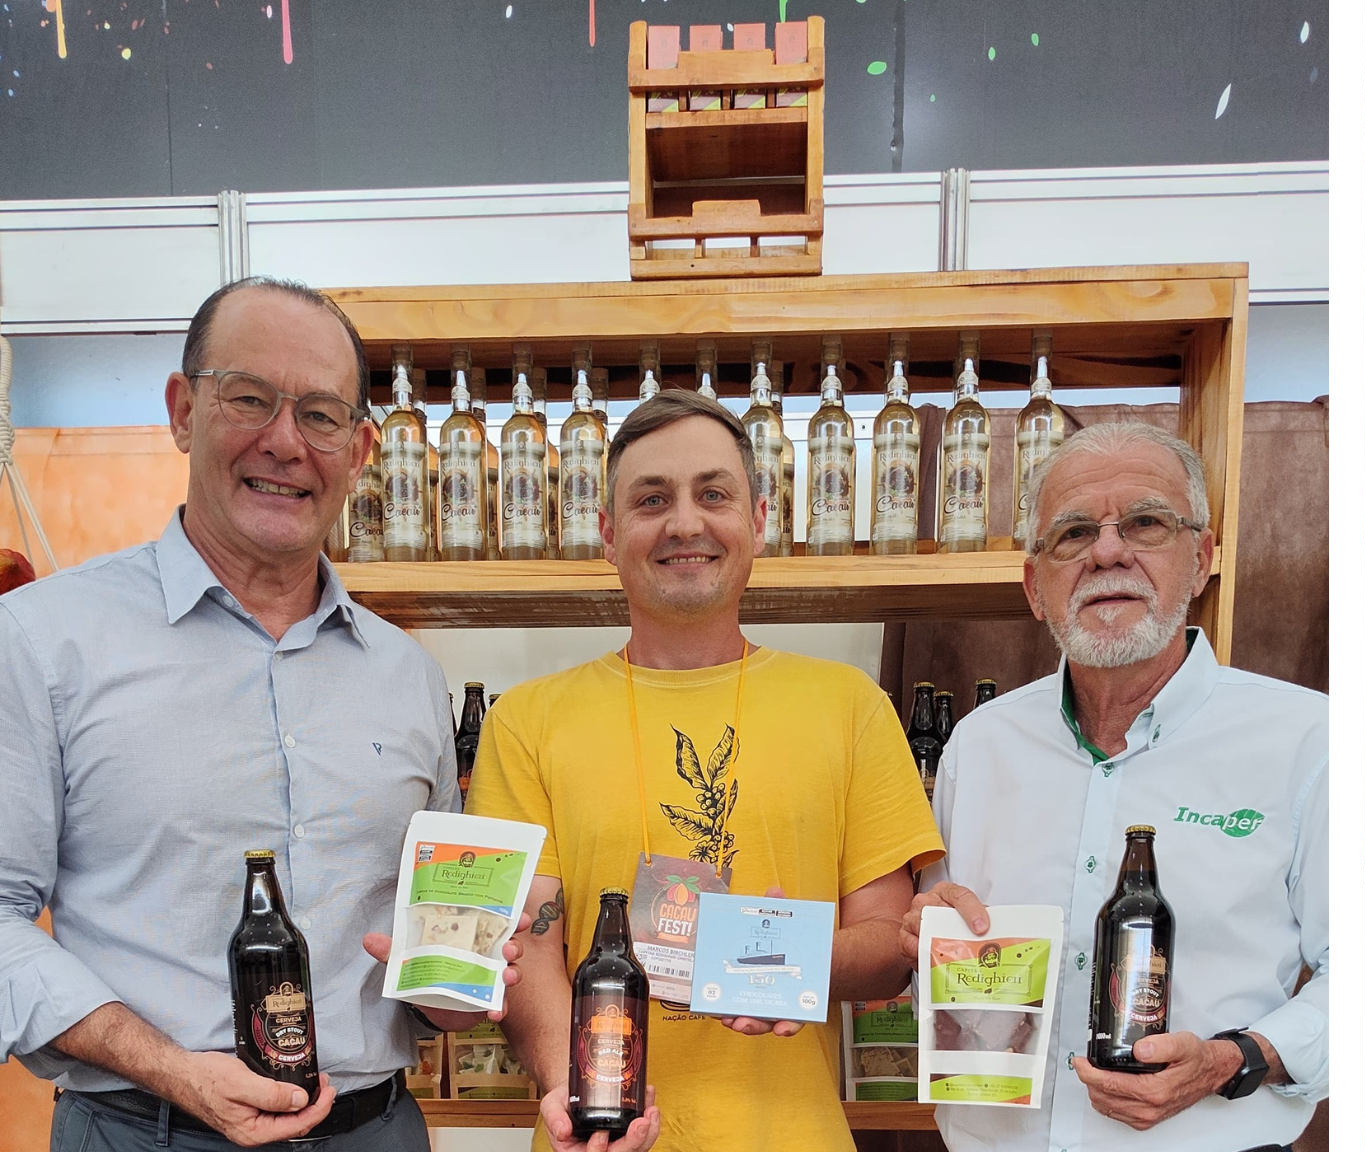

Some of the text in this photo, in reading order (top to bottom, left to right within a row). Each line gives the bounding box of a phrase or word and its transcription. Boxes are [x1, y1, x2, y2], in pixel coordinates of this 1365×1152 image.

[1173, 806, 1263, 831] Incaper
[660, 903, 698, 922] CACAU
[657, 917, 694, 937] FEST!
[661, 1013, 688, 1023] NAÇÃO
[277, 1037, 306, 1048] CACAU
[278, 1051, 307, 1063] CERVEJA
